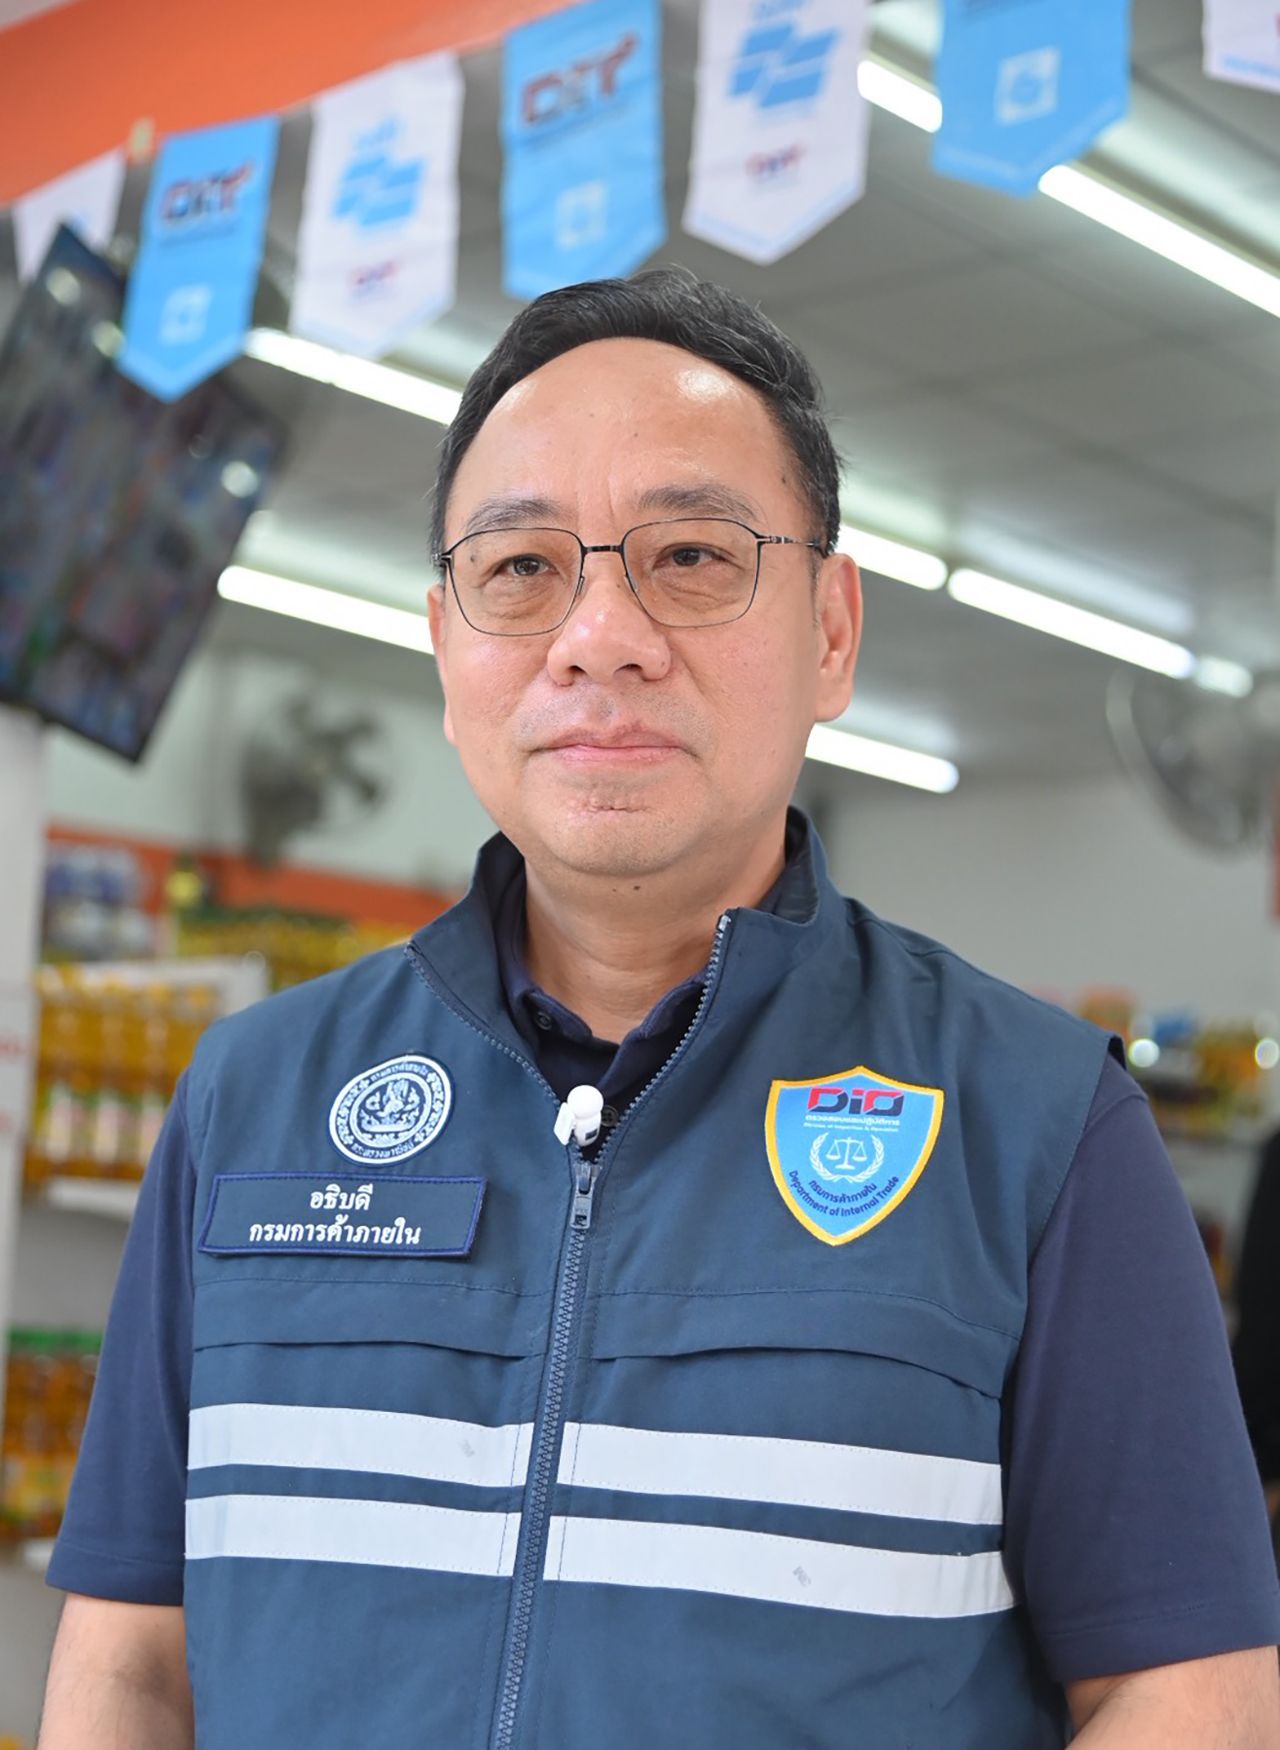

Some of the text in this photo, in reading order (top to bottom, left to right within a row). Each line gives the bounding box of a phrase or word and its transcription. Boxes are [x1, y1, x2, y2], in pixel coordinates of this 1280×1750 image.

[309, 1183, 374, 1211] อธิบดี
[789, 1170, 899, 1217] Department of Internal Trade
[808, 1179, 877, 1204] กรมการค้าภายใน
[249, 1213, 422, 1245] กรมการค้าภายใน
